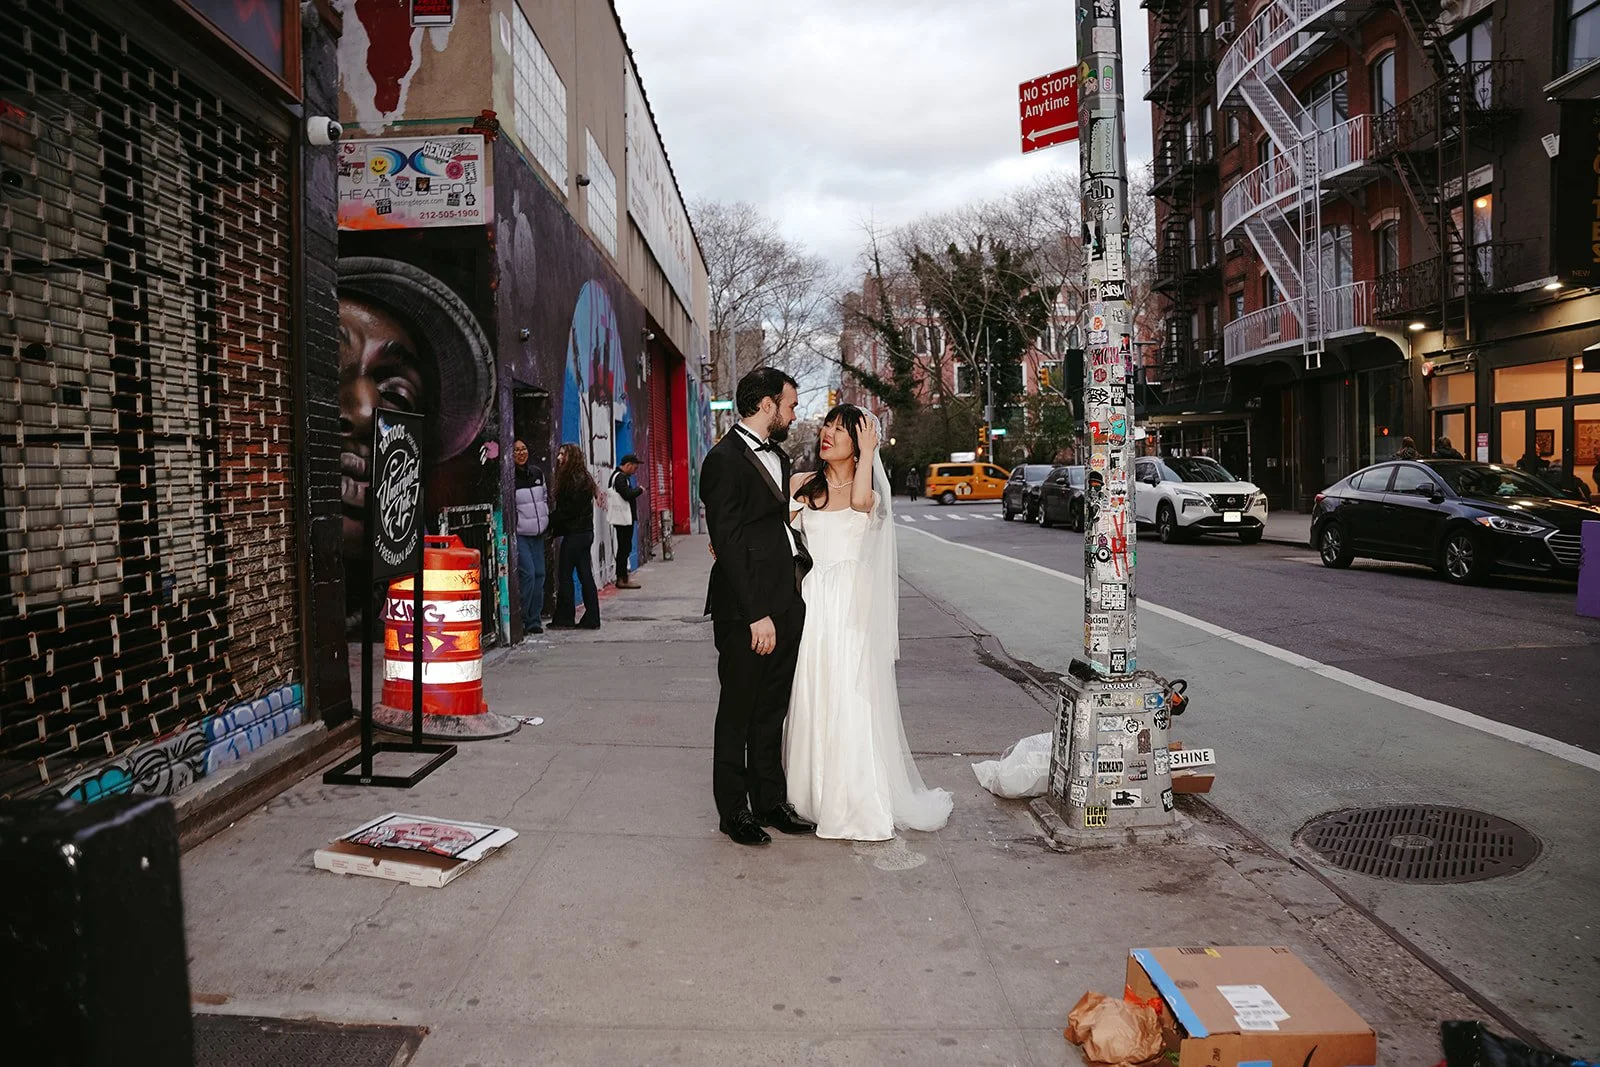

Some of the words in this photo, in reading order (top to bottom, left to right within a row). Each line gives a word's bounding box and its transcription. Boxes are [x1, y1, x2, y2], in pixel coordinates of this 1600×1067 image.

[1023, 87, 1039, 103] NO
[1025, 96, 1070, 118] Anytime
[340, 187, 412, 201] HEATING
[420, 210, 479, 220] 212-505-1900
[379, 424, 405, 455] TATTOOS
[379, 542, 405, 566] FREEMAN
[405, 529, 418, 560] ALLEY
[1098, 761, 1124, 773] REMAND
[1086, 807, 1107, 816] EIGHT
[1086, 816, 1107, 825] LUCY
